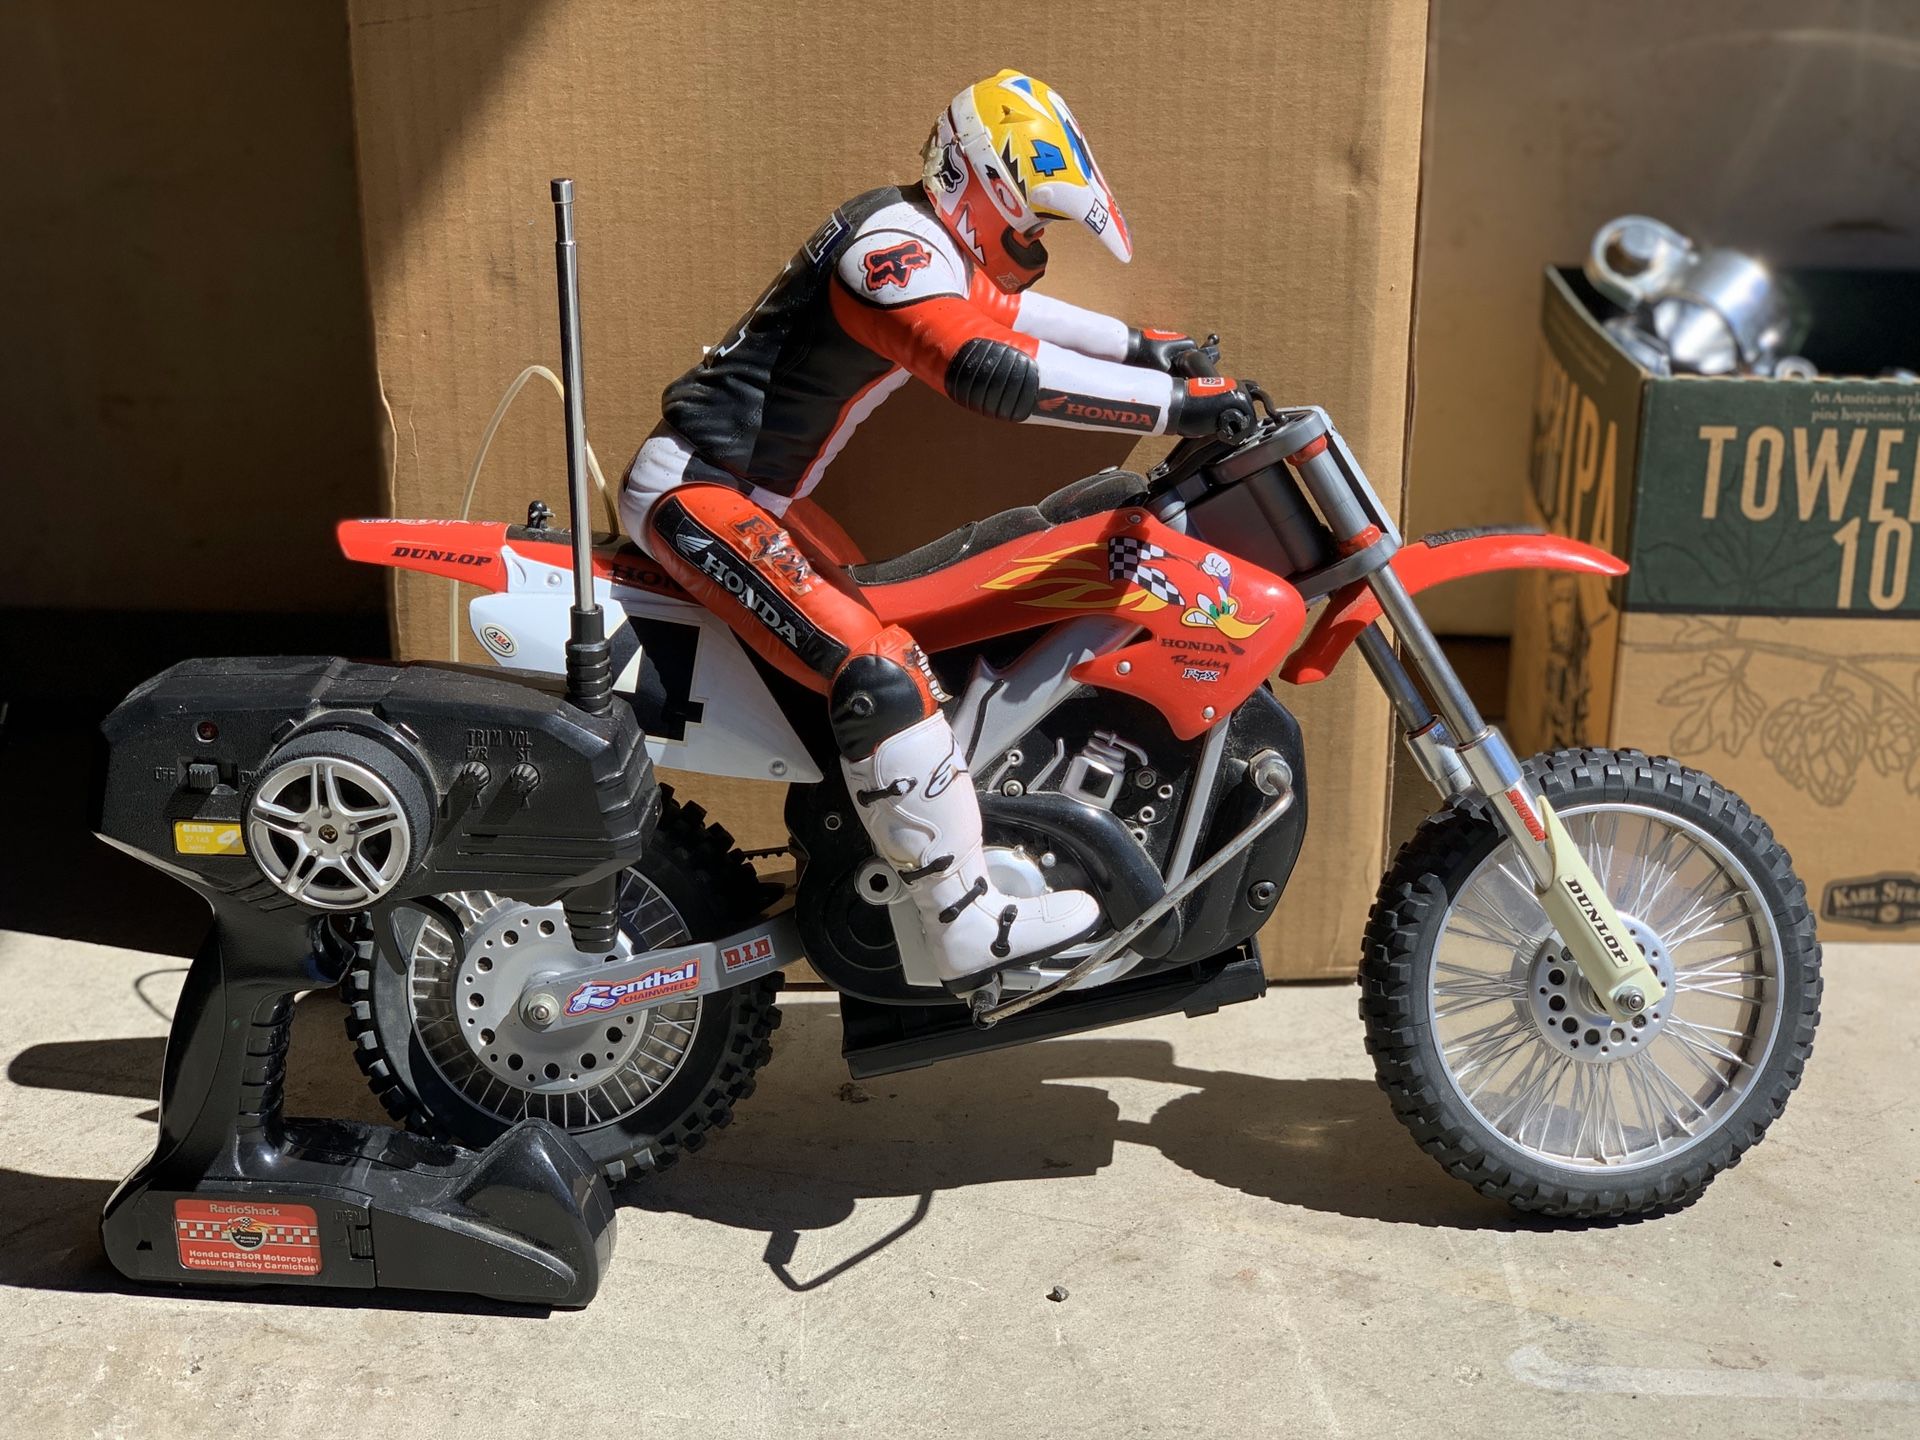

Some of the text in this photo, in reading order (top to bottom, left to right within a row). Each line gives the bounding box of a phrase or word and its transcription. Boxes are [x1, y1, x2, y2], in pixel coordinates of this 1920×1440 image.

[1029, 138, 1068, 178] 4
[1065, 403, 1153, 426] HONDA
[1699, 425, 1920, 522] TOWE
[391, 546, 492, 567] DUNLOP
[1832, 516, 1914, 610] 10
[700, 552, 798, 648] HONDA
[488, 630, 512, 650] AMA
[1160, 638, 1228, 654] HONDA
[1171, 654, 1231, 675] Racing
[466, 728, 534, 746] TRIM VOL
[1564, 878, 1628, 963] DUNLOP
[623, 980, 697, 1004] CHAINWHEELS
[209, 1203, 280, 1217] RadioShack
[189, 1249, 317, 1265] Honda CR250R Motorcycle
[189, 1258, 319, 1272] Featuring Ricky Carmichael
